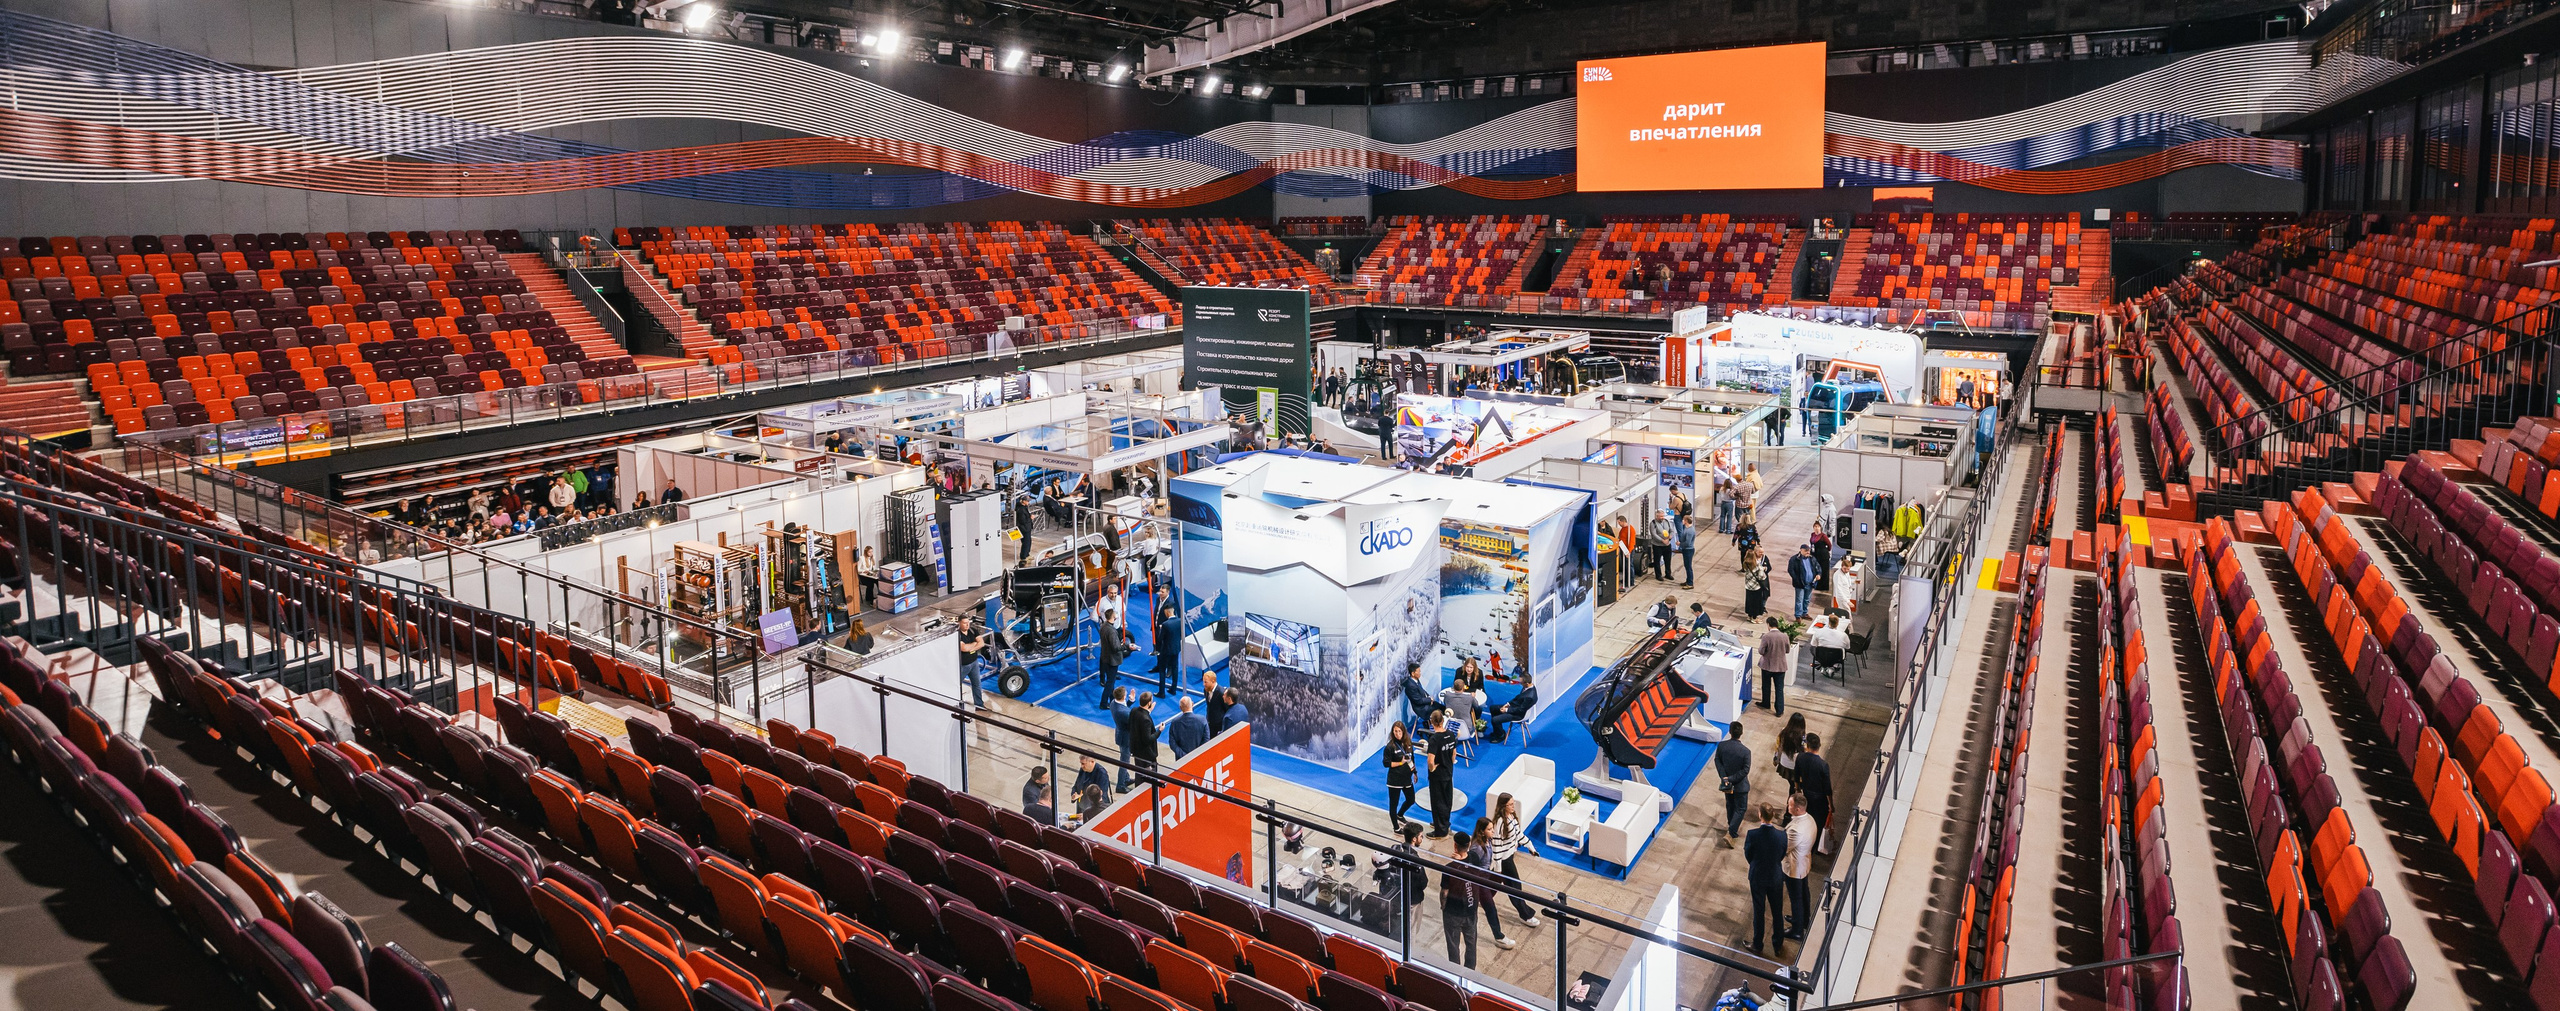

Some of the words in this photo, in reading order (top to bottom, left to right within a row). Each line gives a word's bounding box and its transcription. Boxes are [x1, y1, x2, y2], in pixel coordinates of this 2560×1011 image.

[1663, 102, 1726, 121] дарит
[1629, 123, 1762, 142] впечатления
[1195, 336, 1236, 345] Проектирование,
[1222, 353, 1256, 361] строительство
[1196, 365, 1230, 374] Строительство
[1113, 451, 1147, 463] РОСИНЖИНИРИНГ
[1042, 457, 1079, 467] РОСИНЖИНИРИНГ
[900, 569, 905, 578] 3
[902, 583, 907, 592] 2
[904, 598, 909, 608] 1
